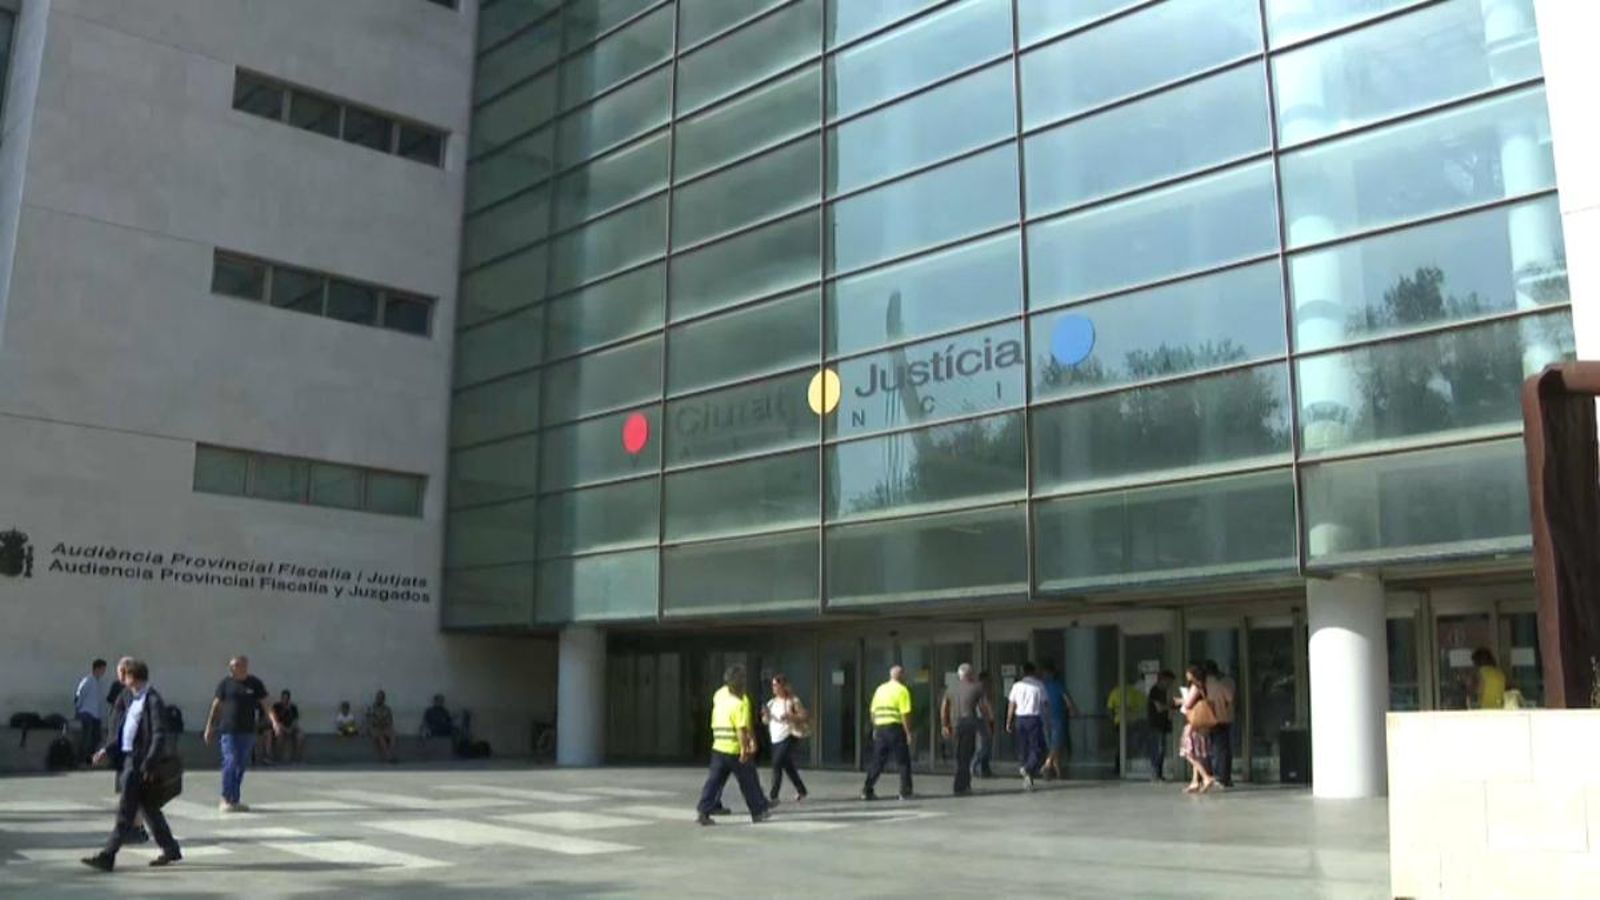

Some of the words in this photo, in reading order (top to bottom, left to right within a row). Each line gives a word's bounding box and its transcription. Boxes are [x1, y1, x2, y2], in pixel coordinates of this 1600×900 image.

[854, 337, 1024, 397] Justícia
[49, 558, 154, 581] Audiencia
[161, 568, 254, 588] Provincial
[334, 586, 343, 598] y
[349, 586, 430, 603] Juzgados
[171, 553, 274, 574] Provincial
[367, 572, 428, 588] Jutjats
